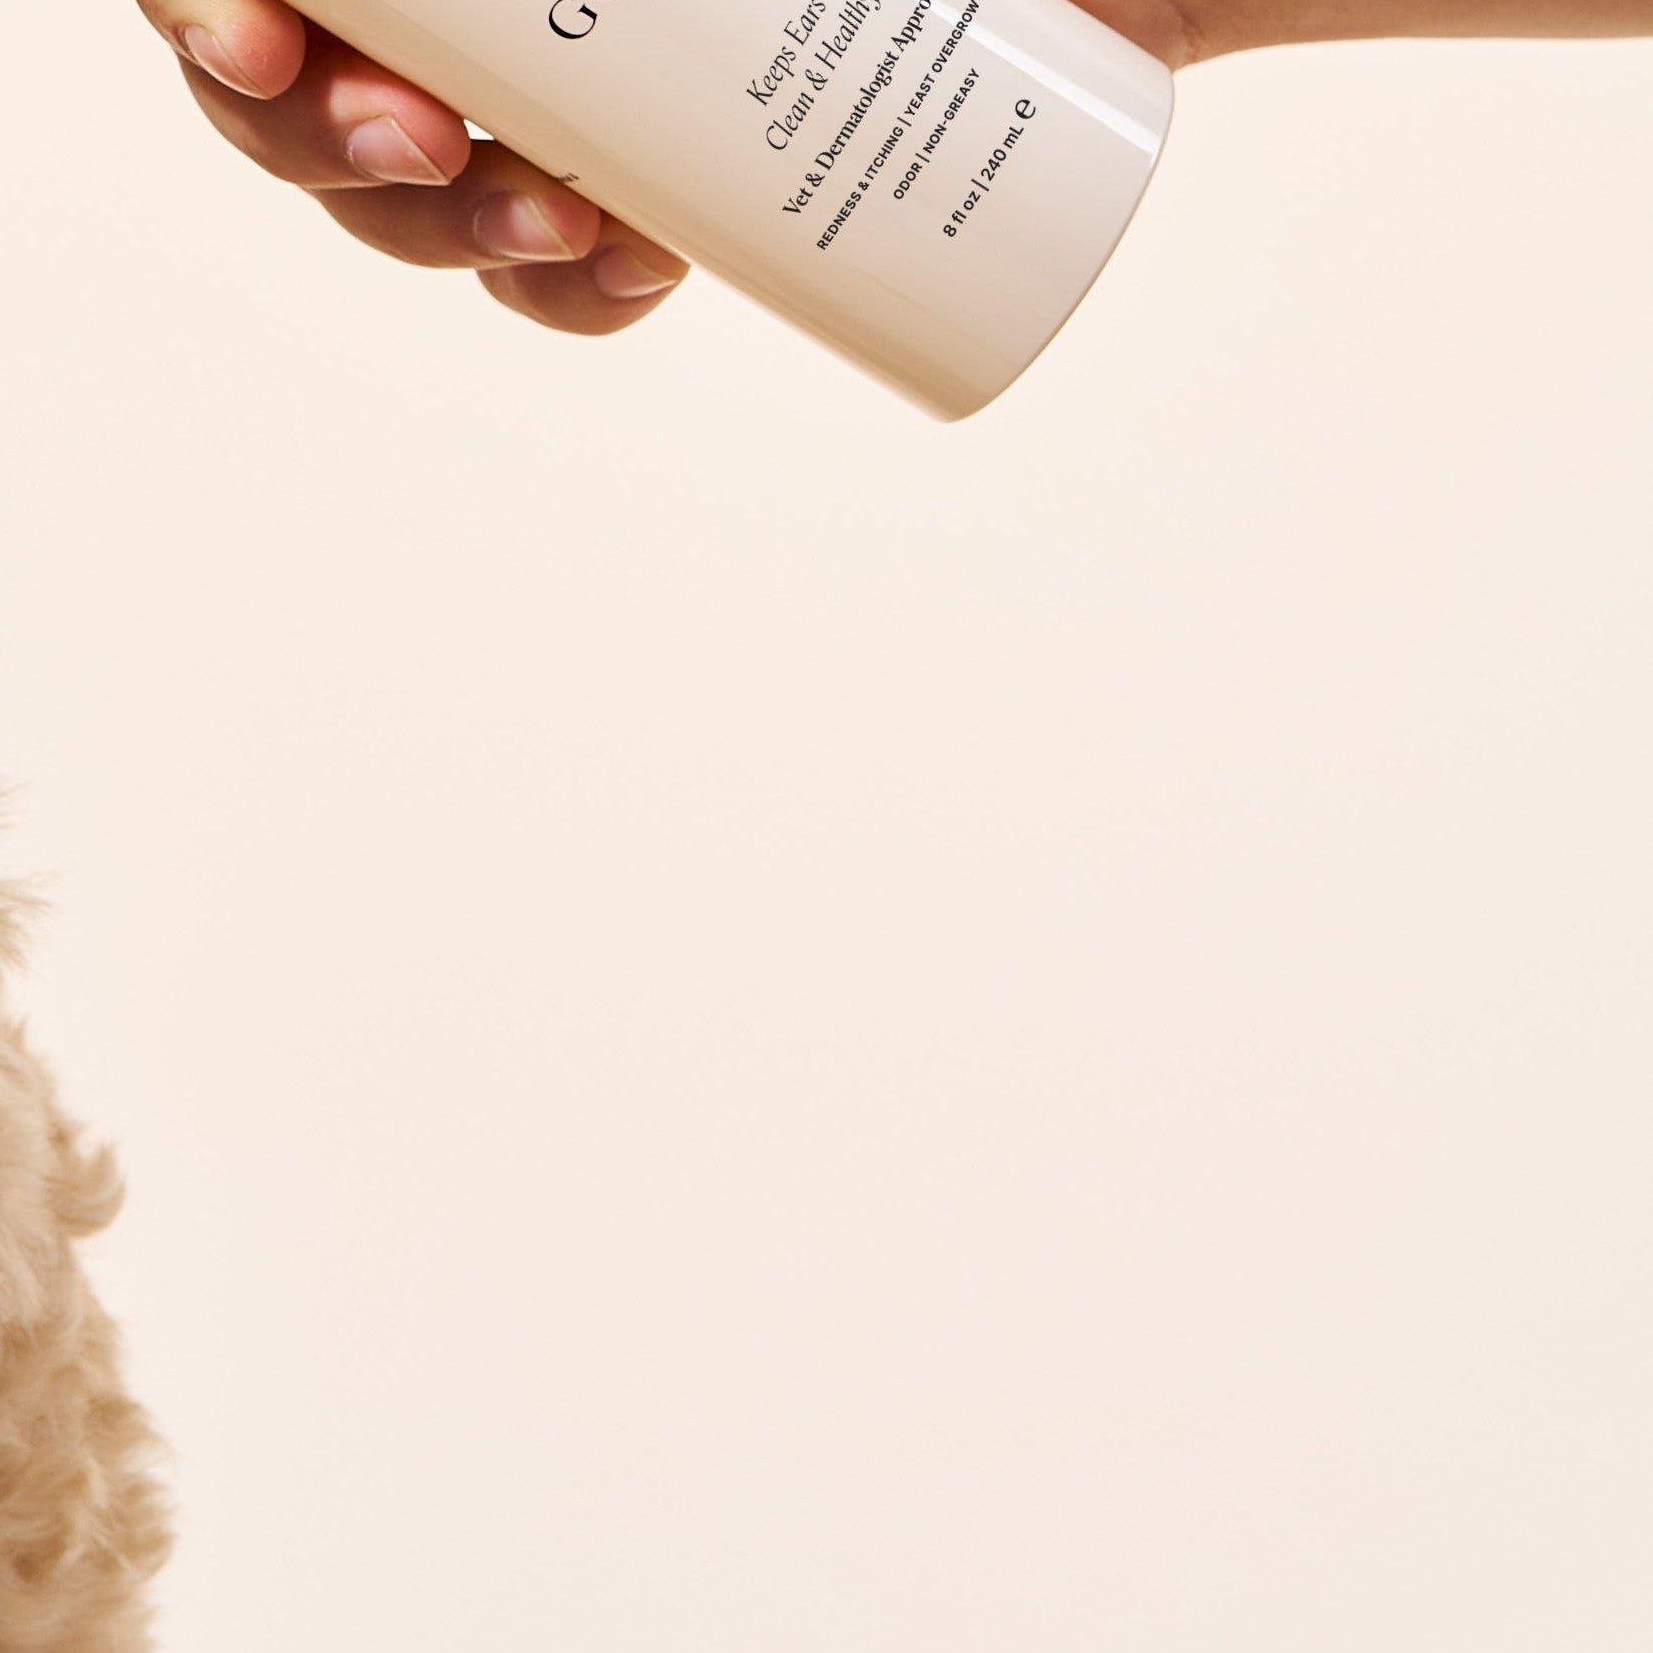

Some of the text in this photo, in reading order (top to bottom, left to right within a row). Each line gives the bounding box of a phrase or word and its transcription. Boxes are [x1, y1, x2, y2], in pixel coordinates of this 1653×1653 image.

[745, 45, 797, 107] Keeps
[765, 92, 815, 151] Clean
[804, 68, 829, 92] &
[814, 50, 900, 171] Dermatologist
[804, 172, 826, 188] &
[815, 191, 862, 251] REDNESS
[857, 180, 871, 192] &
[864, 126, 904, 181] ITCHING
[903, 73, 936, 116] YEAST
[893, 162, 923, 200] ODOR
[922, 67, 980, 155] NON-GREASY
[942, 224, 958, 238] 8
[951, 209, 968, 225] fl
[963, 190, 982, 211] oz
[980, 148, 1007, 182] 240
[1002, 126, 1025, 150] mL
[781, 187, 814, 214] Vet
